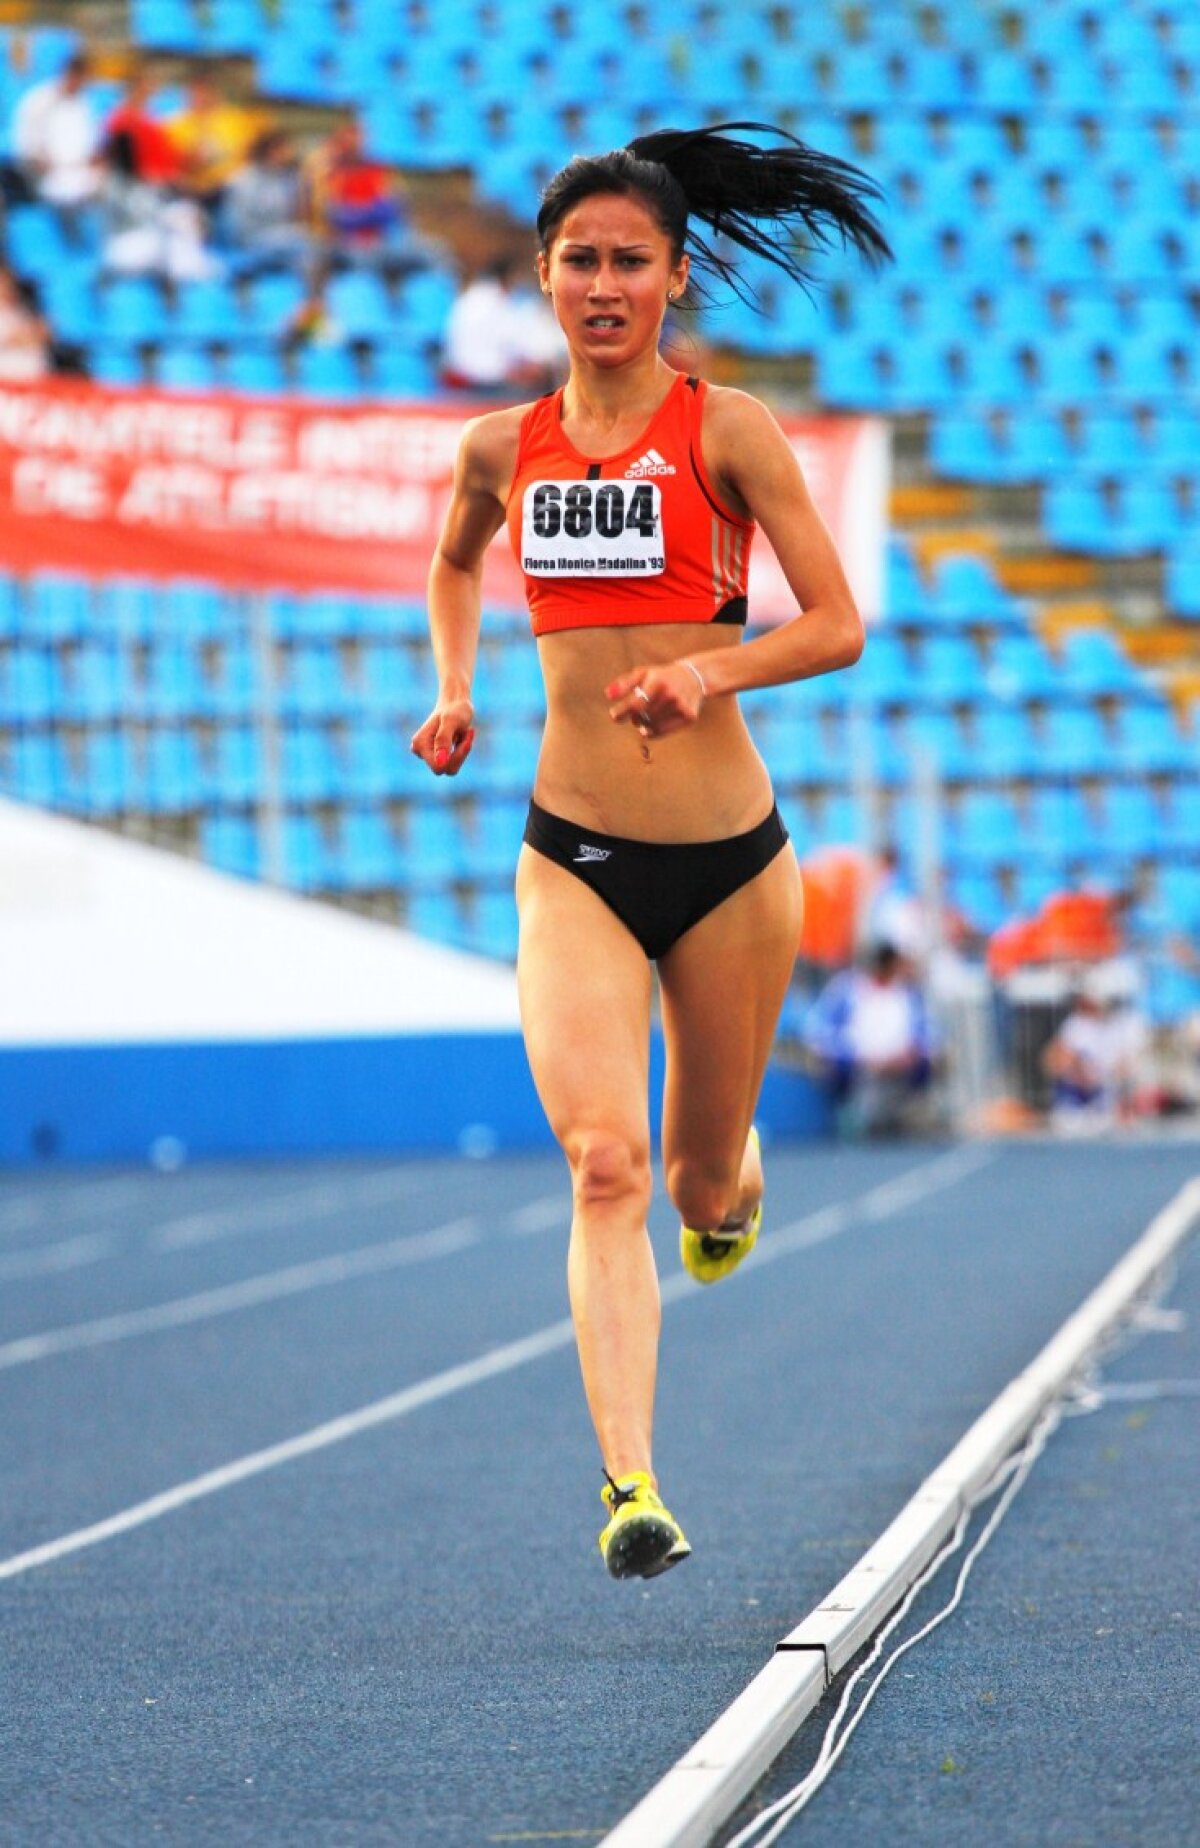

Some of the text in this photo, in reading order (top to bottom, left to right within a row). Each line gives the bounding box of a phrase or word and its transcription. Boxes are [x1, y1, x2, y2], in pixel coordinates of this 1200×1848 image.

[624, 464, 676, 478] adidas
[533, 484, 655, 538] 6804
[524, 557, 664, 570] Florea Monica Madalina '93
